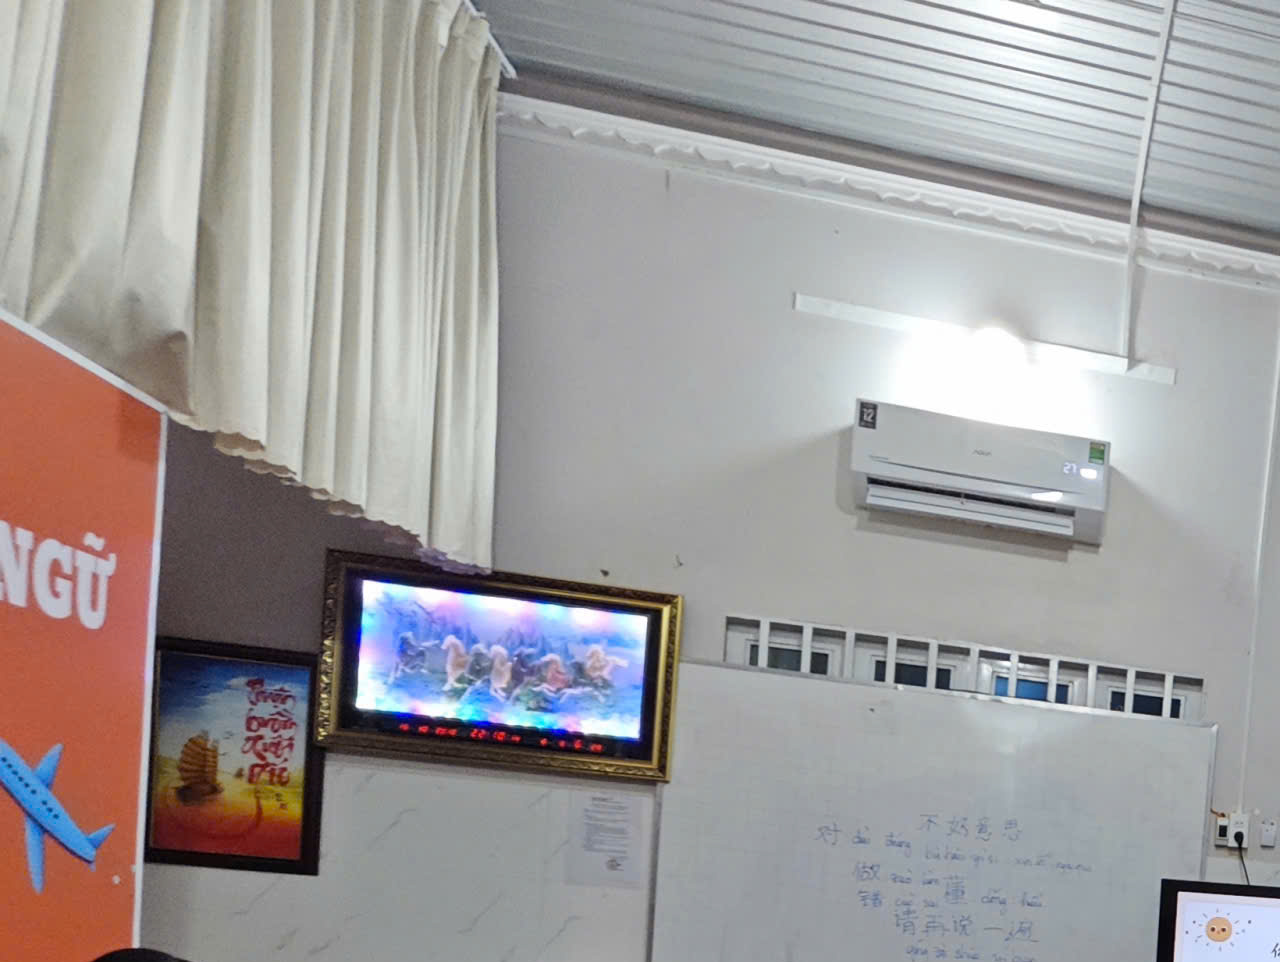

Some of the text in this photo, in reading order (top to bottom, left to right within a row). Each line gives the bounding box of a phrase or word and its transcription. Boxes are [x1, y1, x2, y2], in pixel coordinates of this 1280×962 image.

[814, 823, 843, 847] 对
[917, 812, 1024, 843] 不好意思
